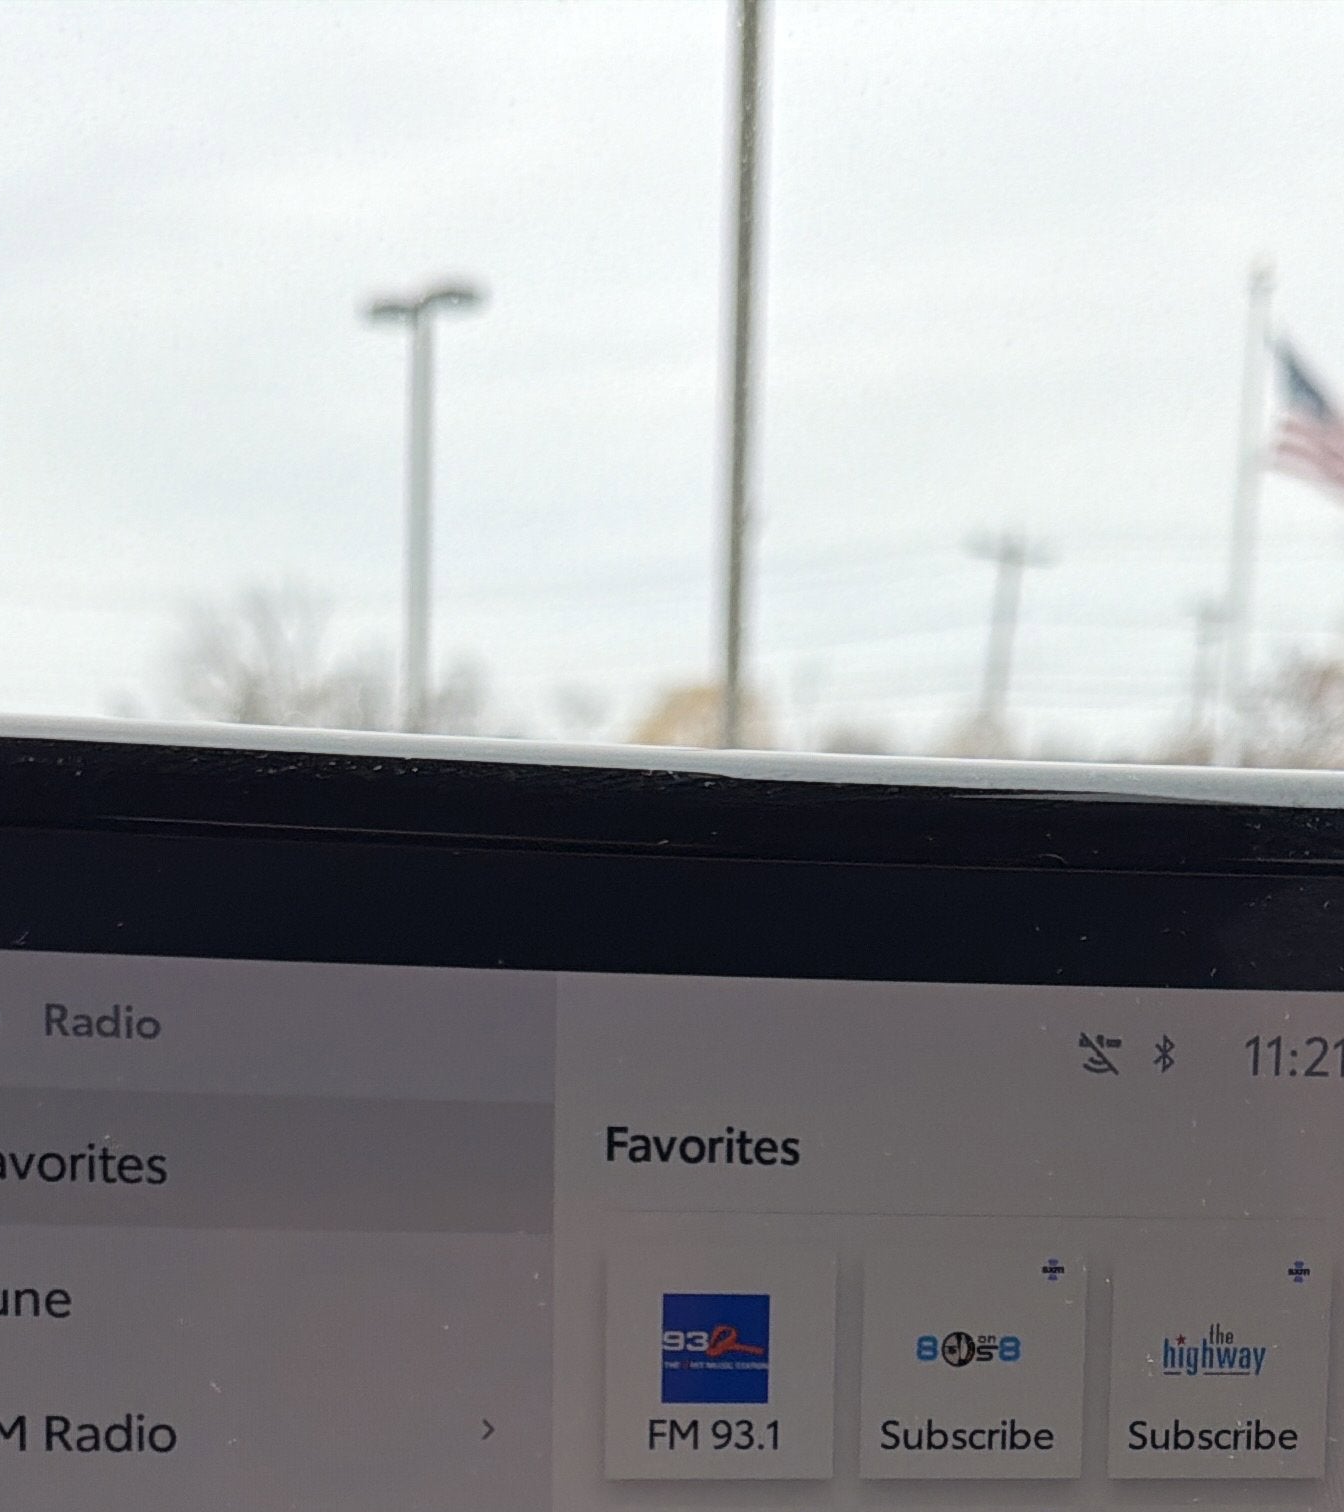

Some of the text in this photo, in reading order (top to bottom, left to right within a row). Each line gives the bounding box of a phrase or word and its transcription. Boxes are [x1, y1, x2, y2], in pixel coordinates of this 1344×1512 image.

[44, 1002, 162, 1040] Radio
[605, 1125, 801, 1166] Favorites
[1209, 1322, 1235, 1345] the
[1162, 1337, 1267, 1376] highway
[44, 1412, 178, 1454] Radio
[648, 1419, 780, 1450] FM 93.1
[879, 1418, 1055, 1451] Subscribe
[1128, 1419, 1299, 1451] Subscribe
